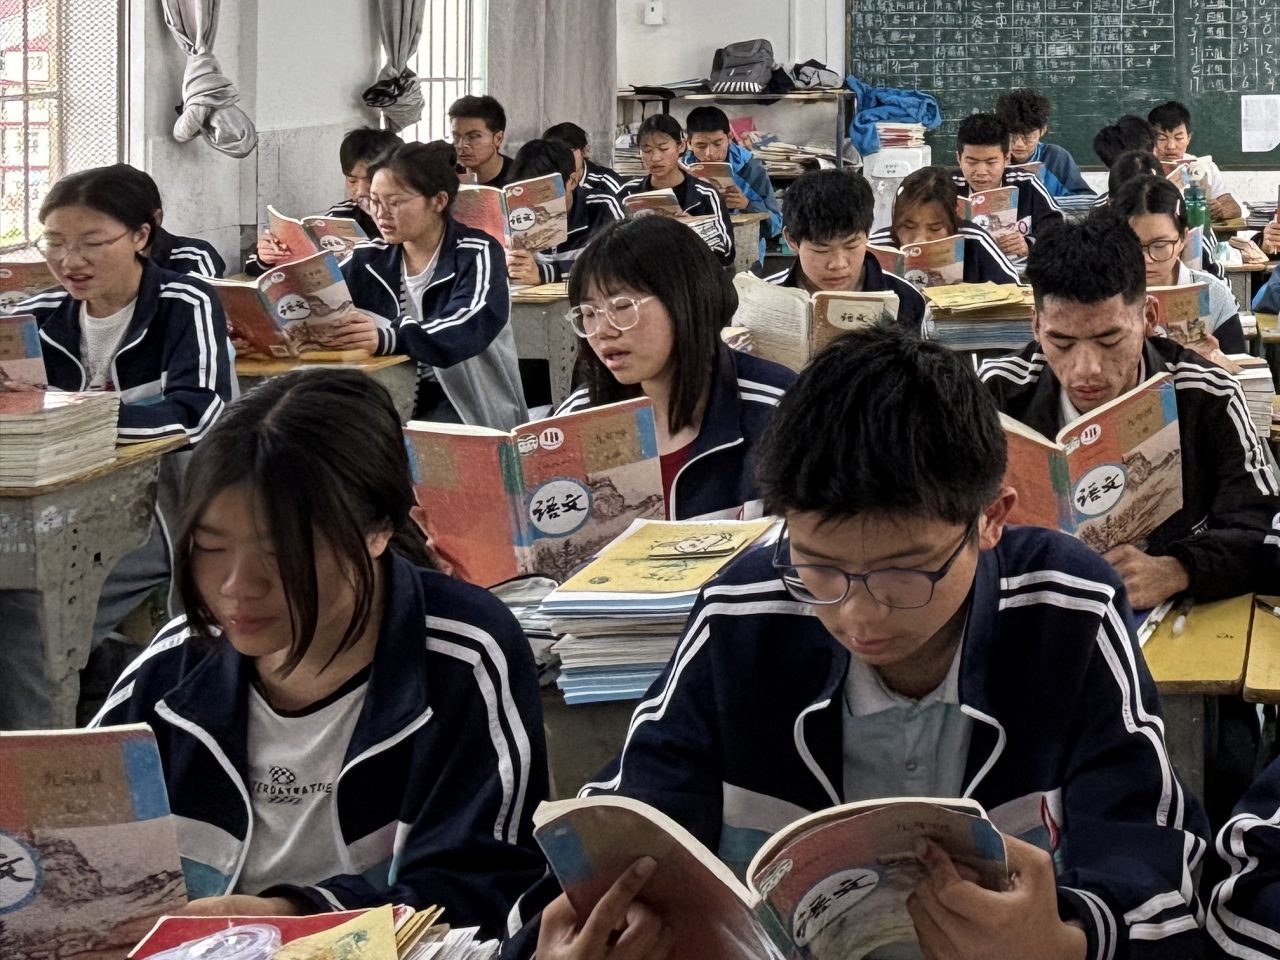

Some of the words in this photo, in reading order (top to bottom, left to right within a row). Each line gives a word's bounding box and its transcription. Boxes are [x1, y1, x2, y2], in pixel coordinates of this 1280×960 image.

[1077, 474, 1123, 507] 语文
[532, 494, 587, 522] 语文
[796, 874, 877, 938] 语文
